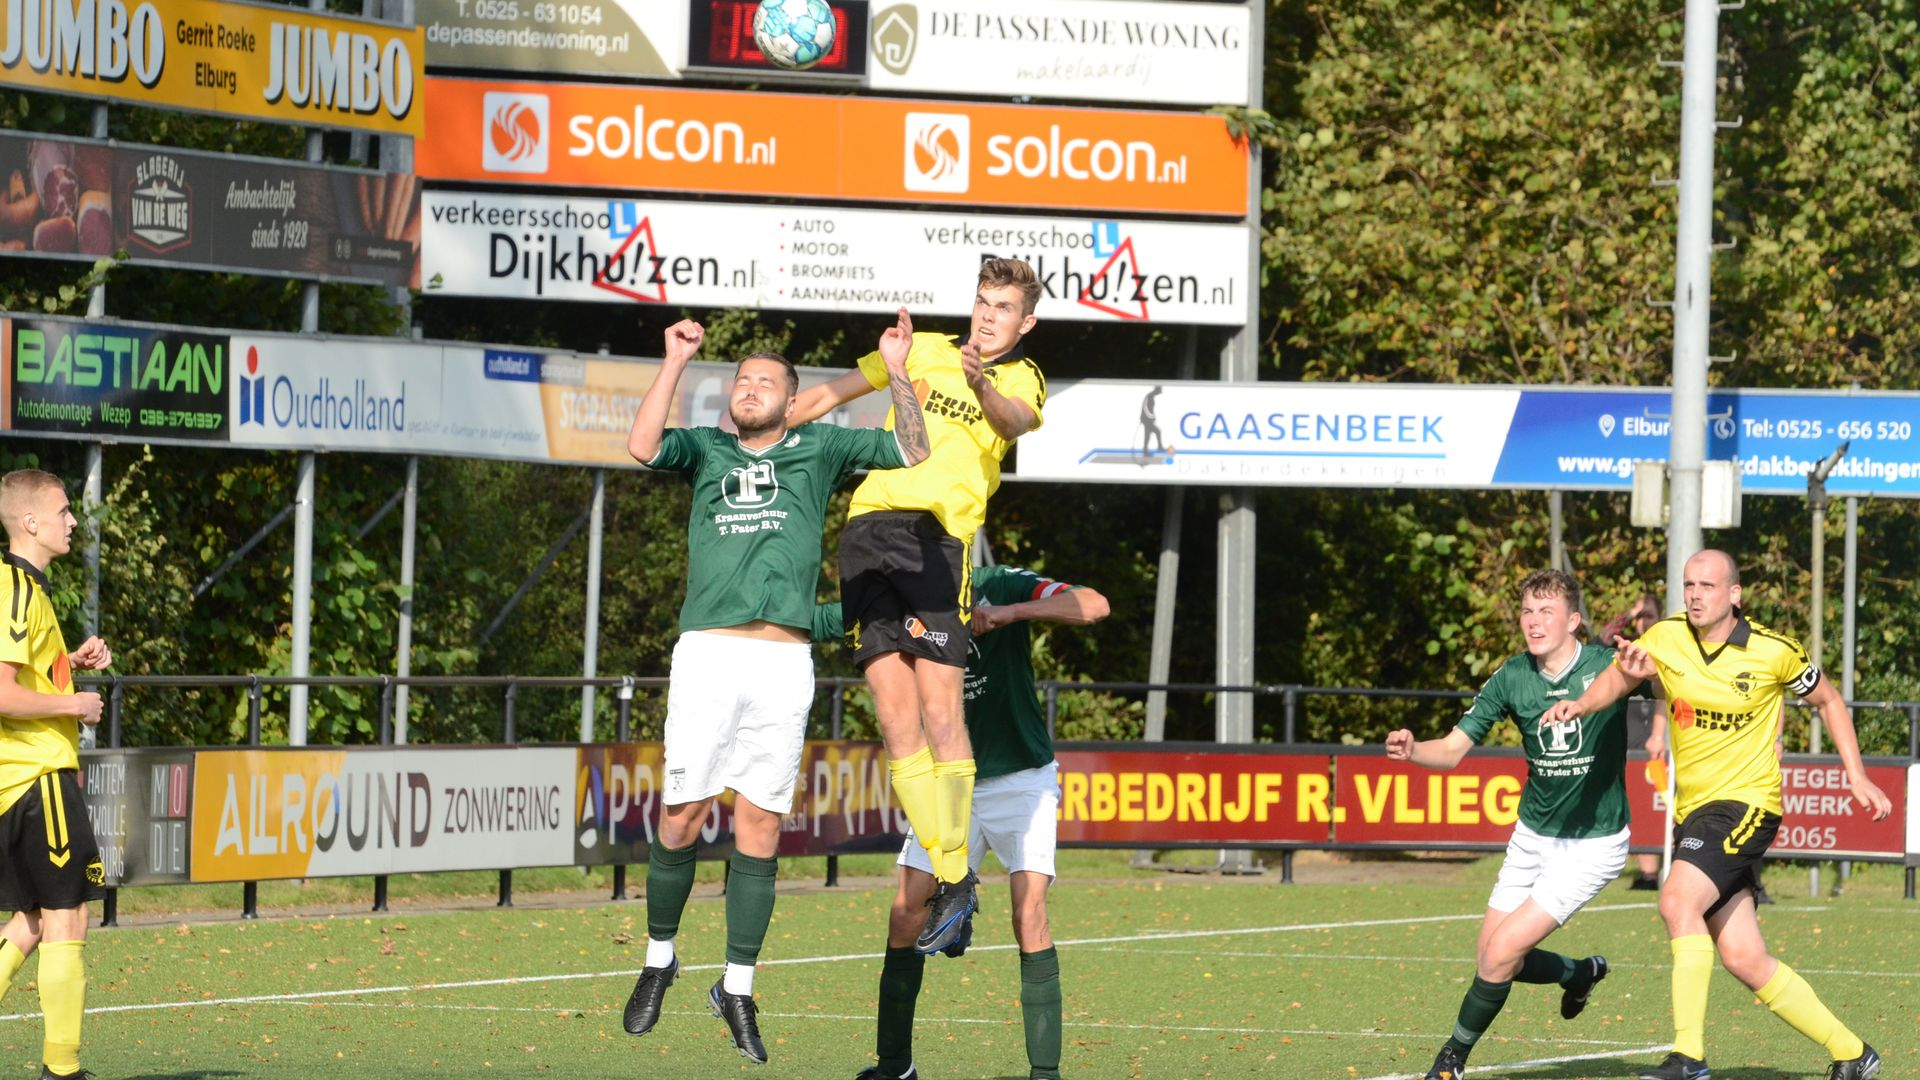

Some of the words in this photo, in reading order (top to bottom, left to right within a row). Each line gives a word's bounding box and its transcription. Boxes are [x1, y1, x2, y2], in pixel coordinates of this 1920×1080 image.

[475, 0, 519, 20] 0525
[0, 0, 166, 89] JUMBO
[176, 19, 213, 48] Gerrit
[216, 25, 256, 53] Roeke
[427, 21, 629, 57] depassendewoning.nl
[929, 11, 967, 37] DE
[975, 15, 1117, 46] PASSENDE
[1124, 21, 1240, 51] WONING
[195, 62, 237, 94] Elburg
[263, 21, 413, 119] JUMBO
[567, 104, 776, 165] solcon.nl
[986, 124, 1187, 184] solcon.nl
[136, 156, 185, 188] SLAGERIJ
[224, 180, 297, 217] Ambachtelijk
[132, 198, 149, 228] VAN
[152, 201, 166, 229] DE
[167, 202, 188, 232] WEG
[793, 219, 835, 235] AUTO
[251, 220, 280, 248] sinds
[281, 221, 308, 248] 1928
[792, 241, 848, 257] MOTOR
[791, 263, 875, 281] BROMFIETS
[790, 286, 934, 305] AANHANGWAGEN
[17, 329, 222, 395] BASTIAAN
[17, 396, 92, 427] Autodemontage
[101, 402, 131, 429] Wezep
[273, 375, 405, 432] Oudholland
[1179, 412, 1444, 443] GAASENBEEK
[1742, 419, 1773, 438] Tel:
[1777, 420, 1822, 439] 0525
[1837, 421, 1872, 440] 656
[1877, 421, 1911, 440] 520
[715, 509, 788, 524] Kraanverhuur
[719, 526, 729, 535] T.
[731, 523, 759, 535] Pater
[761, 520, 783, 531] B.V.
[88, 763, 126, 795] HATTEM
[1547, 768, 1571, 777] Pater
[1297, 773, 1346, 823] R.
[214, 772, 432, 857] ALLROUND
[444, 786, 560, 833] ZONWERING
